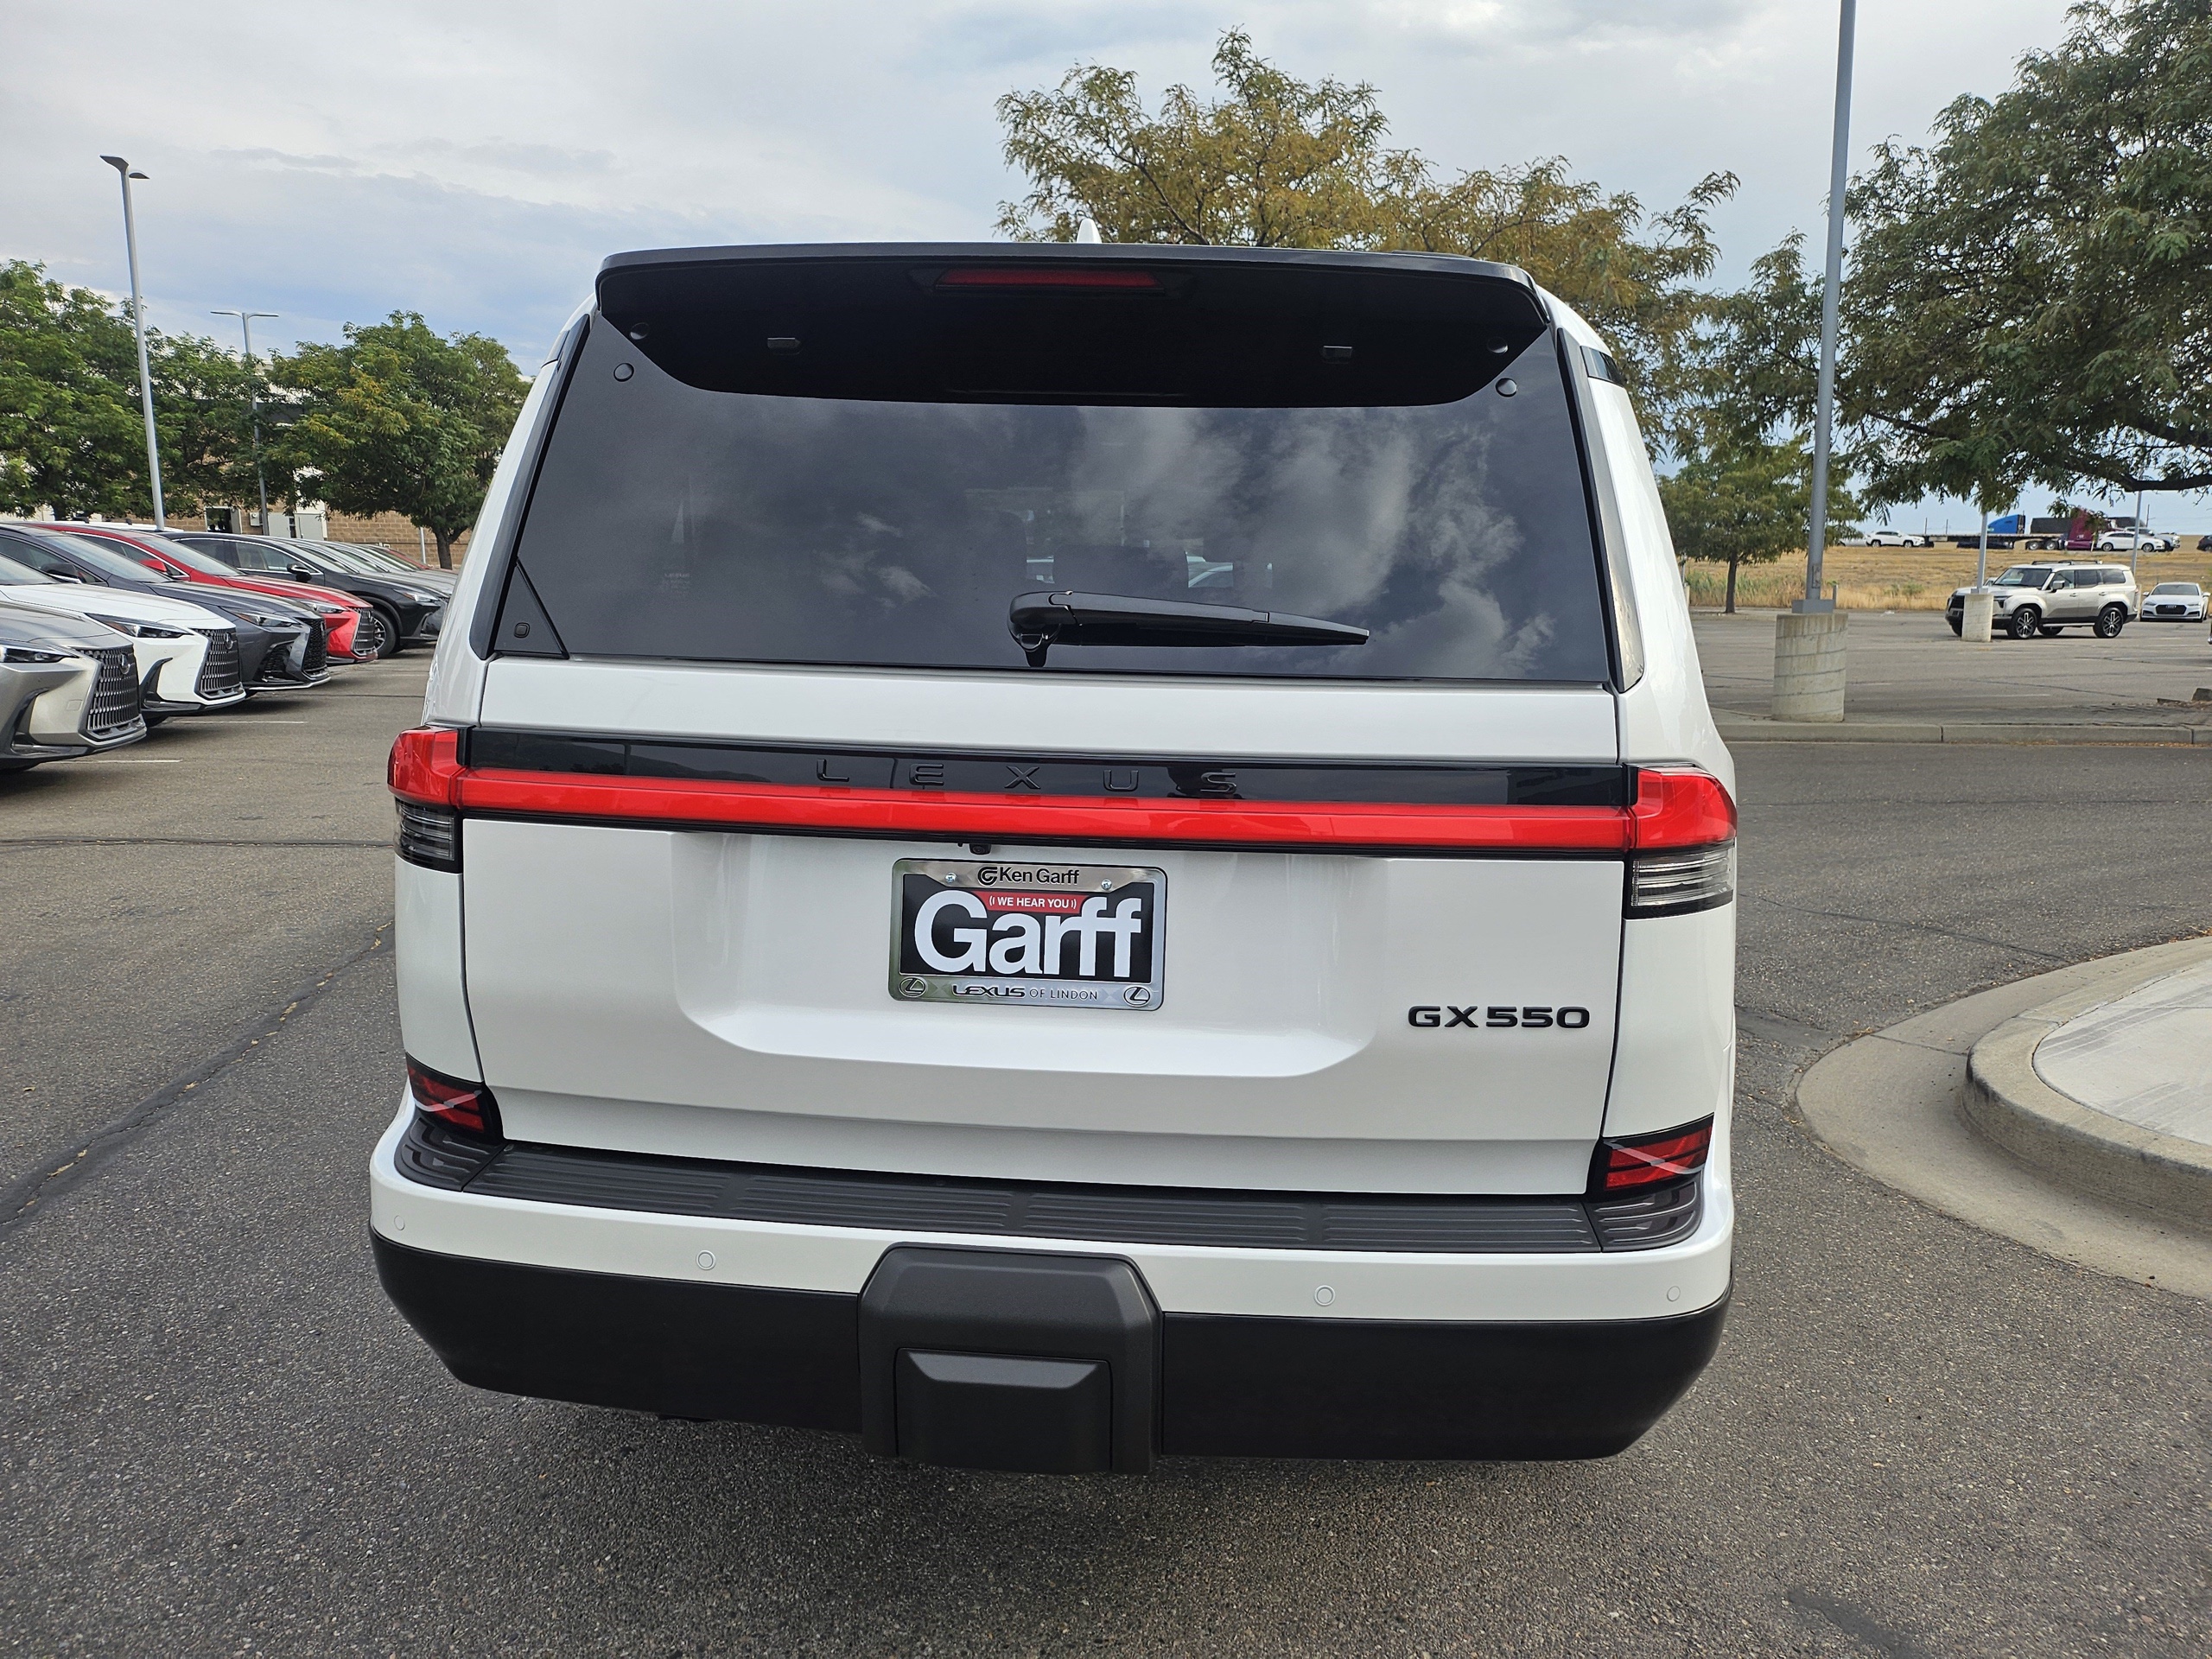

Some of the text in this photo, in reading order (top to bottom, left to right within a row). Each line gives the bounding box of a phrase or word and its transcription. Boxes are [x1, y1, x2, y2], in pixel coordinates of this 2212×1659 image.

[816, 758, 1238, 794] LEXUS
[1000, 867, 1080, 885] Ken Garff
[997, 896, 1070, 909] WE HEAR YOU
[914, 889, 1142, 978] Garff
[952, 984, 1098, 1001] LEXUS OF LINDON
